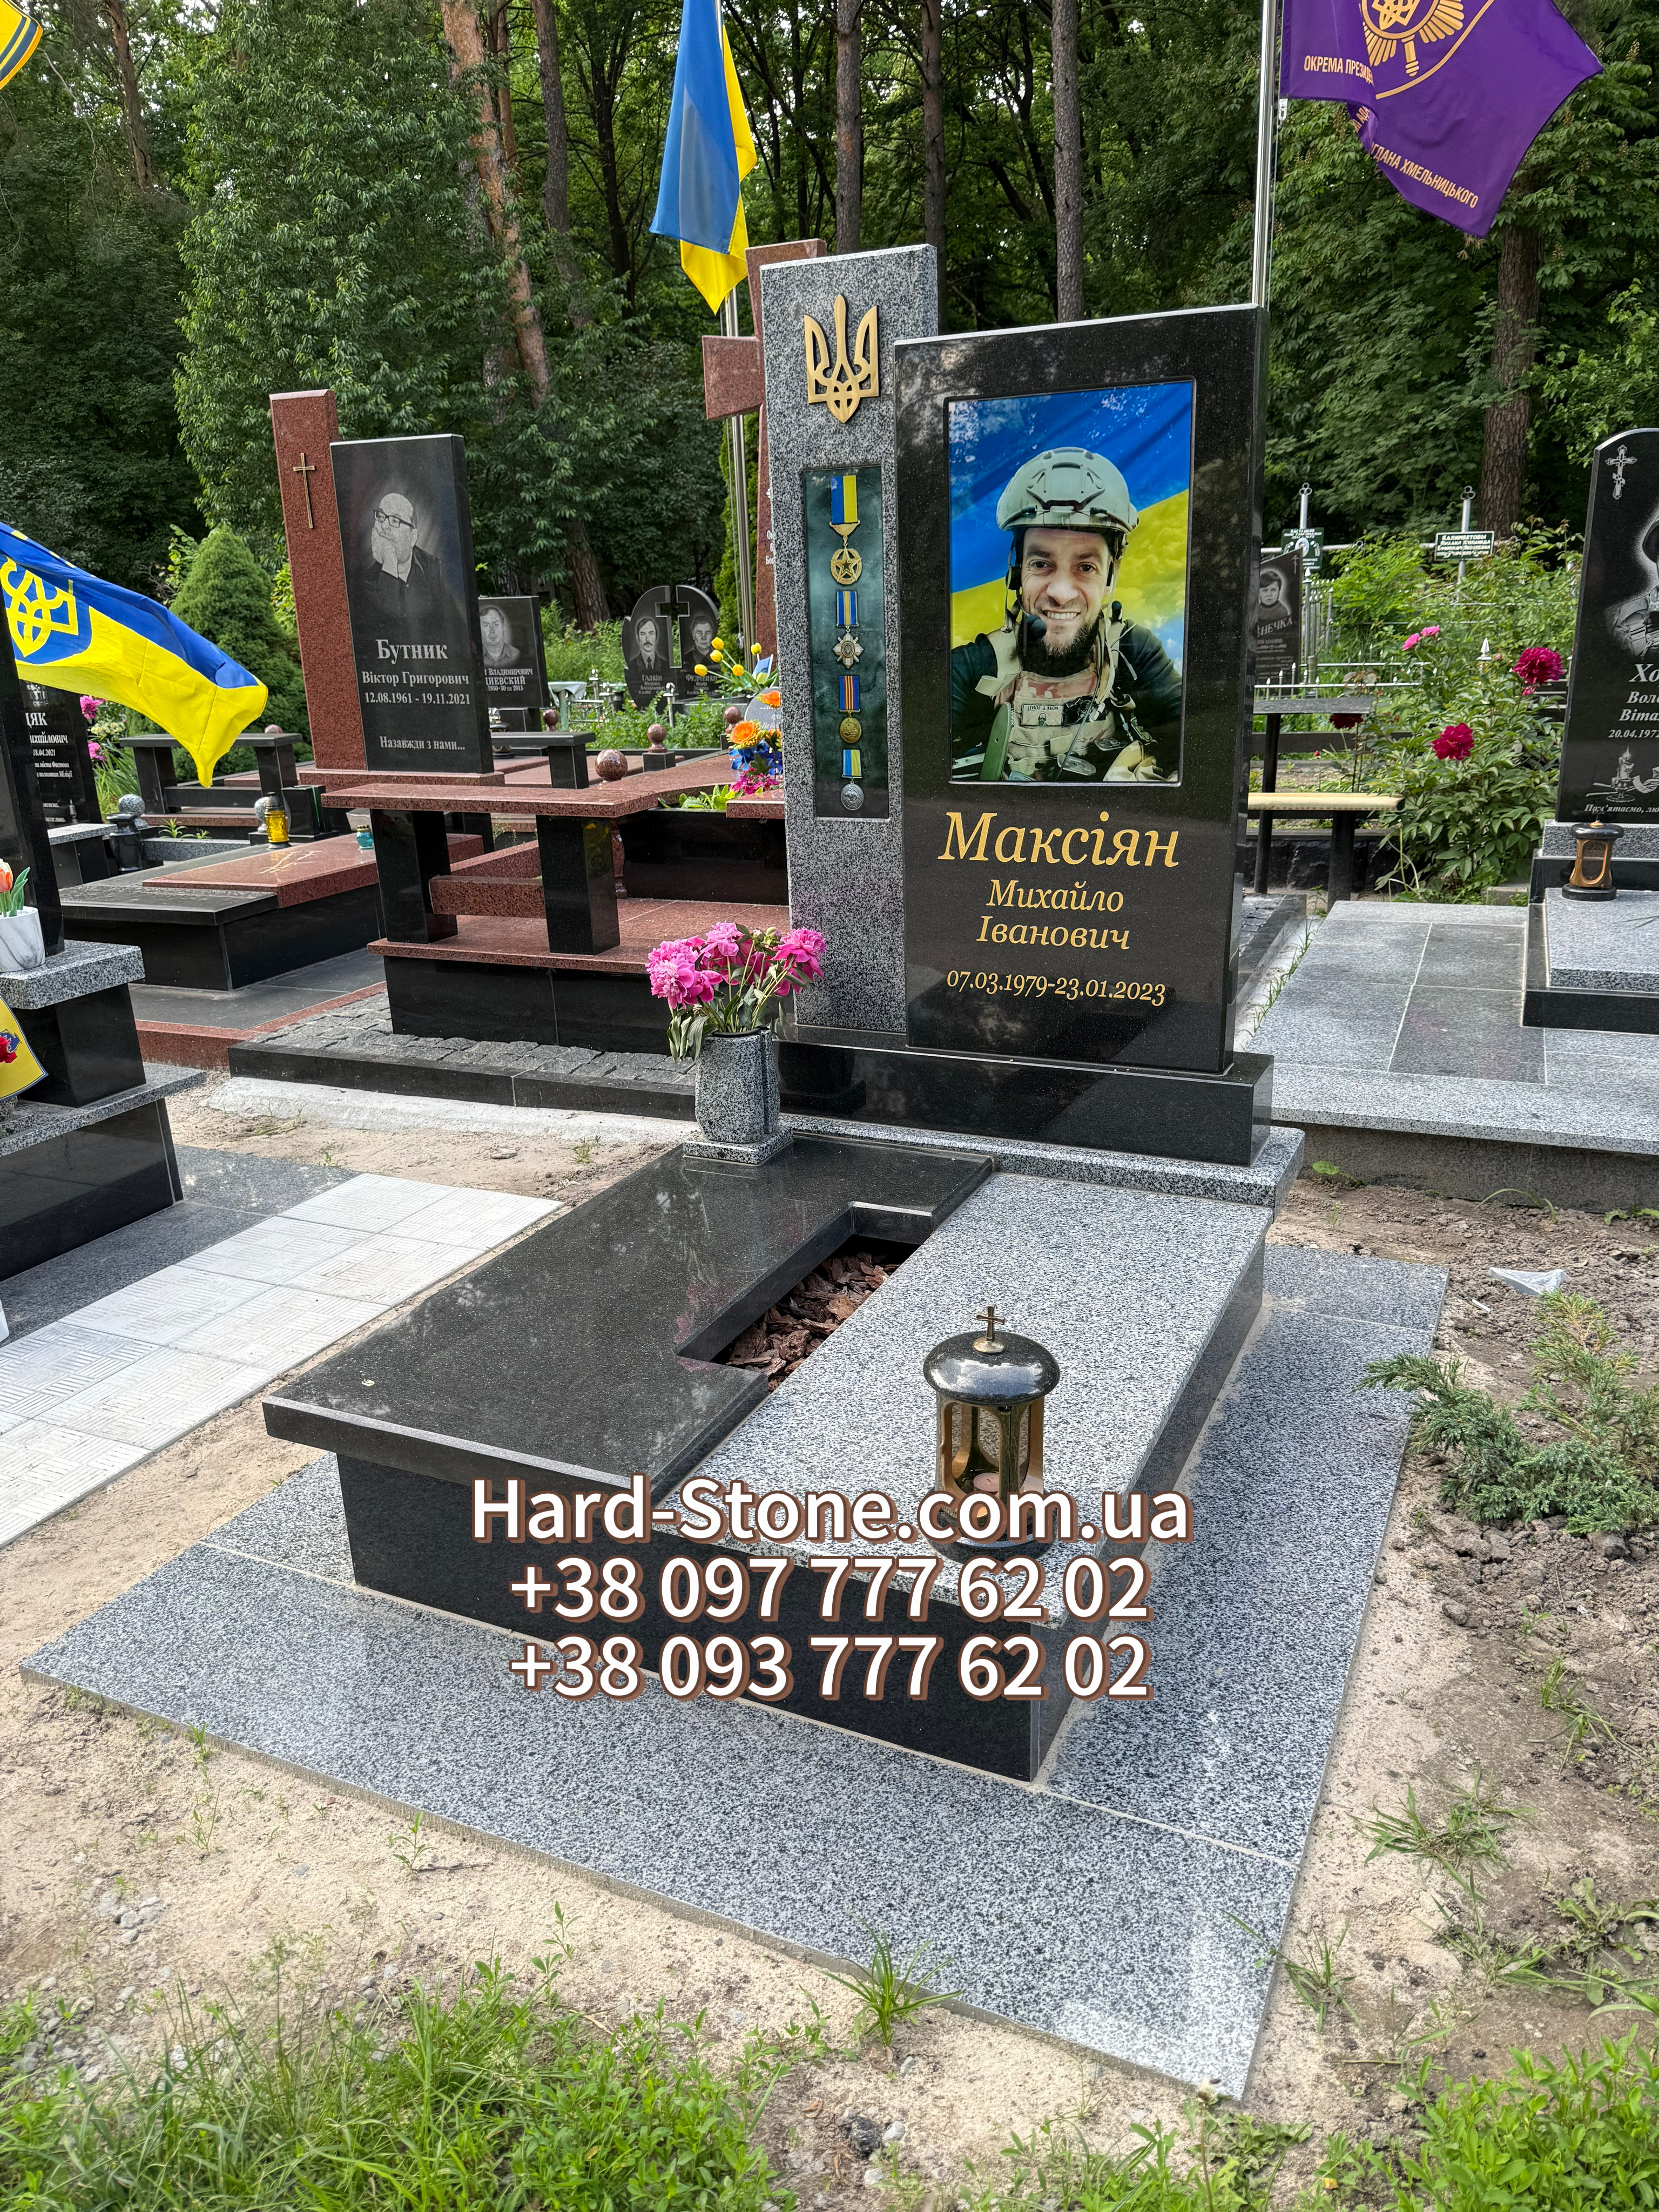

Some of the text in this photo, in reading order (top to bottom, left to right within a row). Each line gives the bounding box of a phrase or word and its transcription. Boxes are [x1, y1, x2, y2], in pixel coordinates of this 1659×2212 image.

[1304, 55, 1344, 73] ОКРЕМА
[1400, 159, 1479, 208] ХМЕЛЬНИЦЬКОГО
[375, 639, 448, 665] Бутник
[362, 671, 399, 687] Віктор
[402, 671, 469, 687] Григорович
[365, 692, 413, 704] 12.08.1961
[422, 693, 470, 705] 19.11.2021
[1618, 709, 1659, 721] Віта
[380, 736, 424, 750] Назавжди
[427, 740, 431, 750] з
[938, 811, 1179, 867] Максіян
[986, 879, 1124, 912] Михайло
[976, 916, 1130, 950] Іванович
